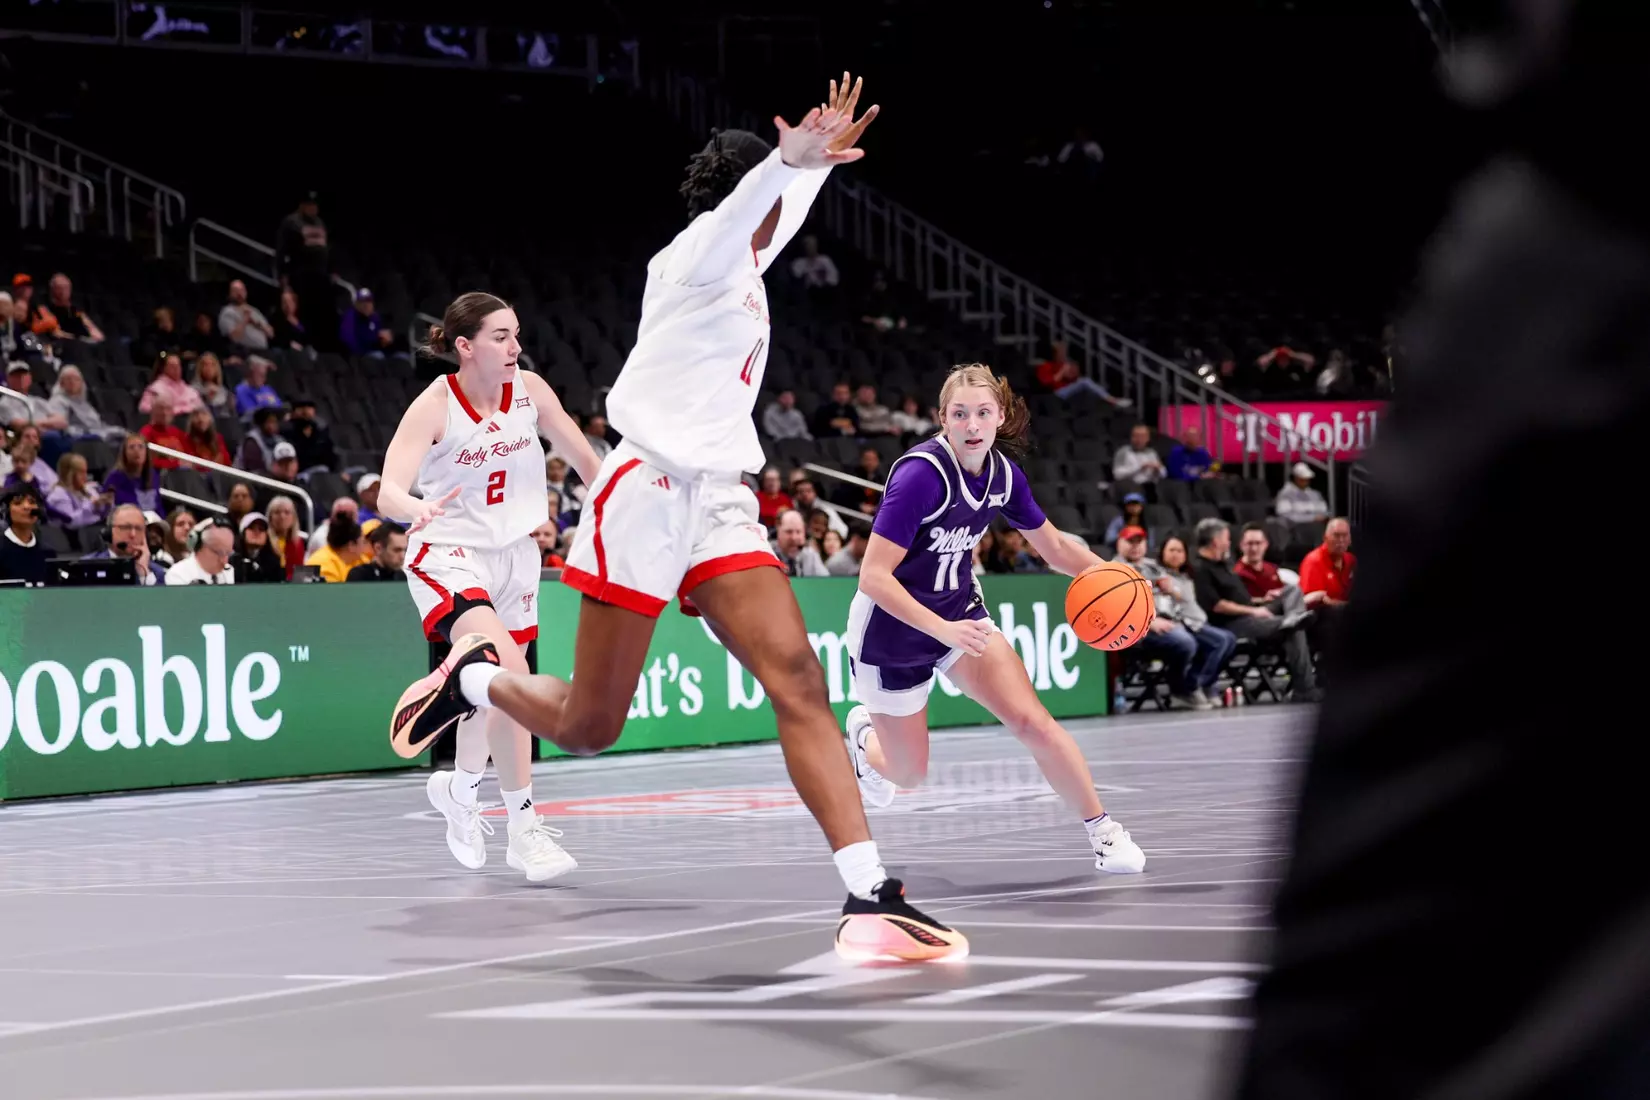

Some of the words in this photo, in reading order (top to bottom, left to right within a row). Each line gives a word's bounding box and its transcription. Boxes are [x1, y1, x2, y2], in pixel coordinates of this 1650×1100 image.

[455, 446, 488, 469] Lady
[487, 470, 507, 506] 2
[933, 551, 965, 592] 11
[0, 623, 283, 755] oable
